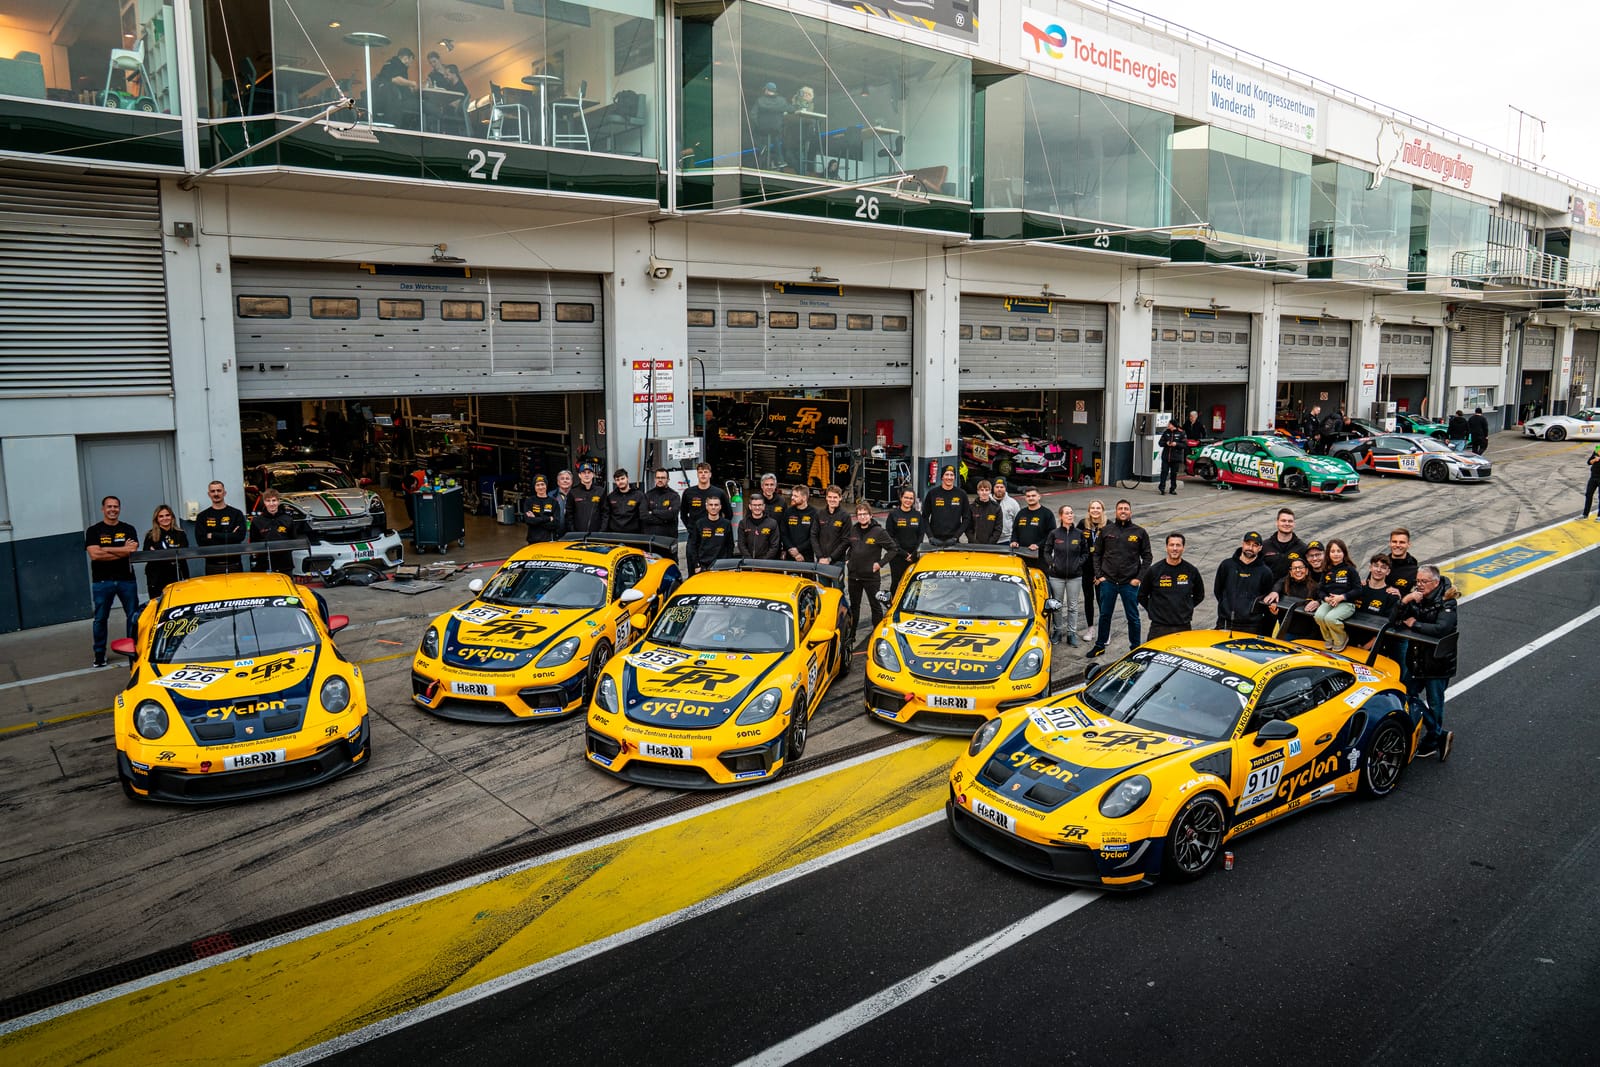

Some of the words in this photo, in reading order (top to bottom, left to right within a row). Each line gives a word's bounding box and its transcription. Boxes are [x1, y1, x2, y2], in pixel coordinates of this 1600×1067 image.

[1071, 35, 1178, 89] TotalEnergies
[1211, 69, 1234, 91] Hotel
[1236, 82, 1252, 97] und
[1253, 85, 1315, 118] Kongresszentrum
[1211, 91, 1256, 119] Wanderath
[468, 149, 507, 181] 27
[1402, 138, 1473, 189] nürburgring
[855, 194, 880, 220] 26
[1093, 227, 1110, 248] 25
[415, 283, 448, 293] Werkzeug
[974, 446, 987, 456] 472
[1199, 446, 1284, 475] Bauman
[1401, 458, 1415, 467] 188
[1234, 466, 1258, 480] LOGISTIK
[1260, 466, 1275, 475] 960
[524, 560, 547, 568] GRAN
[546, 561, 580, 569] TURISMO
[959, 571, 993, 579] TURISMO
[194, 602, 223, 613] GRAN
[223, 598, 266, 611] TURISMO
[723, 597, 762, 606] TURISMO
[468, 608, 499, 620] 951
[163, 617, 200, 639] 926
[906, 620, 940, 632] 952
[457, 647, 517, 663] cyclon
[639, 652, 678, 665] 953
[922, 660, 985, 674] cyclon
[1153, 654, 1179, 666] GRAN
[1179, 659, 1222, 677] TURISMO
[172, 670, 217, 683] 926
[533, 671, 556, 679] sonic
[877, 673, 896, 682] sonic
[457, 683, 476, 693] H&R
[1012, 683, 1032, 691] sonic
[641, 700, 711, 717] cyclon
[934, 696, 954, 707] H&R
[206, 701, 285, 720] cyclon
[593, 713, 610, 726] sonic
[1045, 708, 1066, 729] 910
[1236, 708, 1252, 734] N.KOCH
[624, 725, 643, 736] Porsche
[644, 729, 669, 739] Zentrum
[669, 733, 712, 742] Aschaffenburg
[737, 729, 762, 739] sonic
[206, 743, 230, 752] Porsche
[230, 739, 256, 749] Zentrum
[647, 744, 670, 756] H&R
[1290, 743, 1300, 757] AM
[234, 756, 261, 768] H&R
[1253, 751, 1283, 767] RAVENOL
[1010, 751, 1073, 783] cyclon
[1248, 765, 1279, 794] 910
[1278, 754, 1338, 801] cyclon
[977, 803, 996, 822] H&R
[984, 790, 1005, 805] Zentrum
[1005, 801, 1046, 821] Aschaffenburg
[1100, 851, 1128, 860] cyclon
